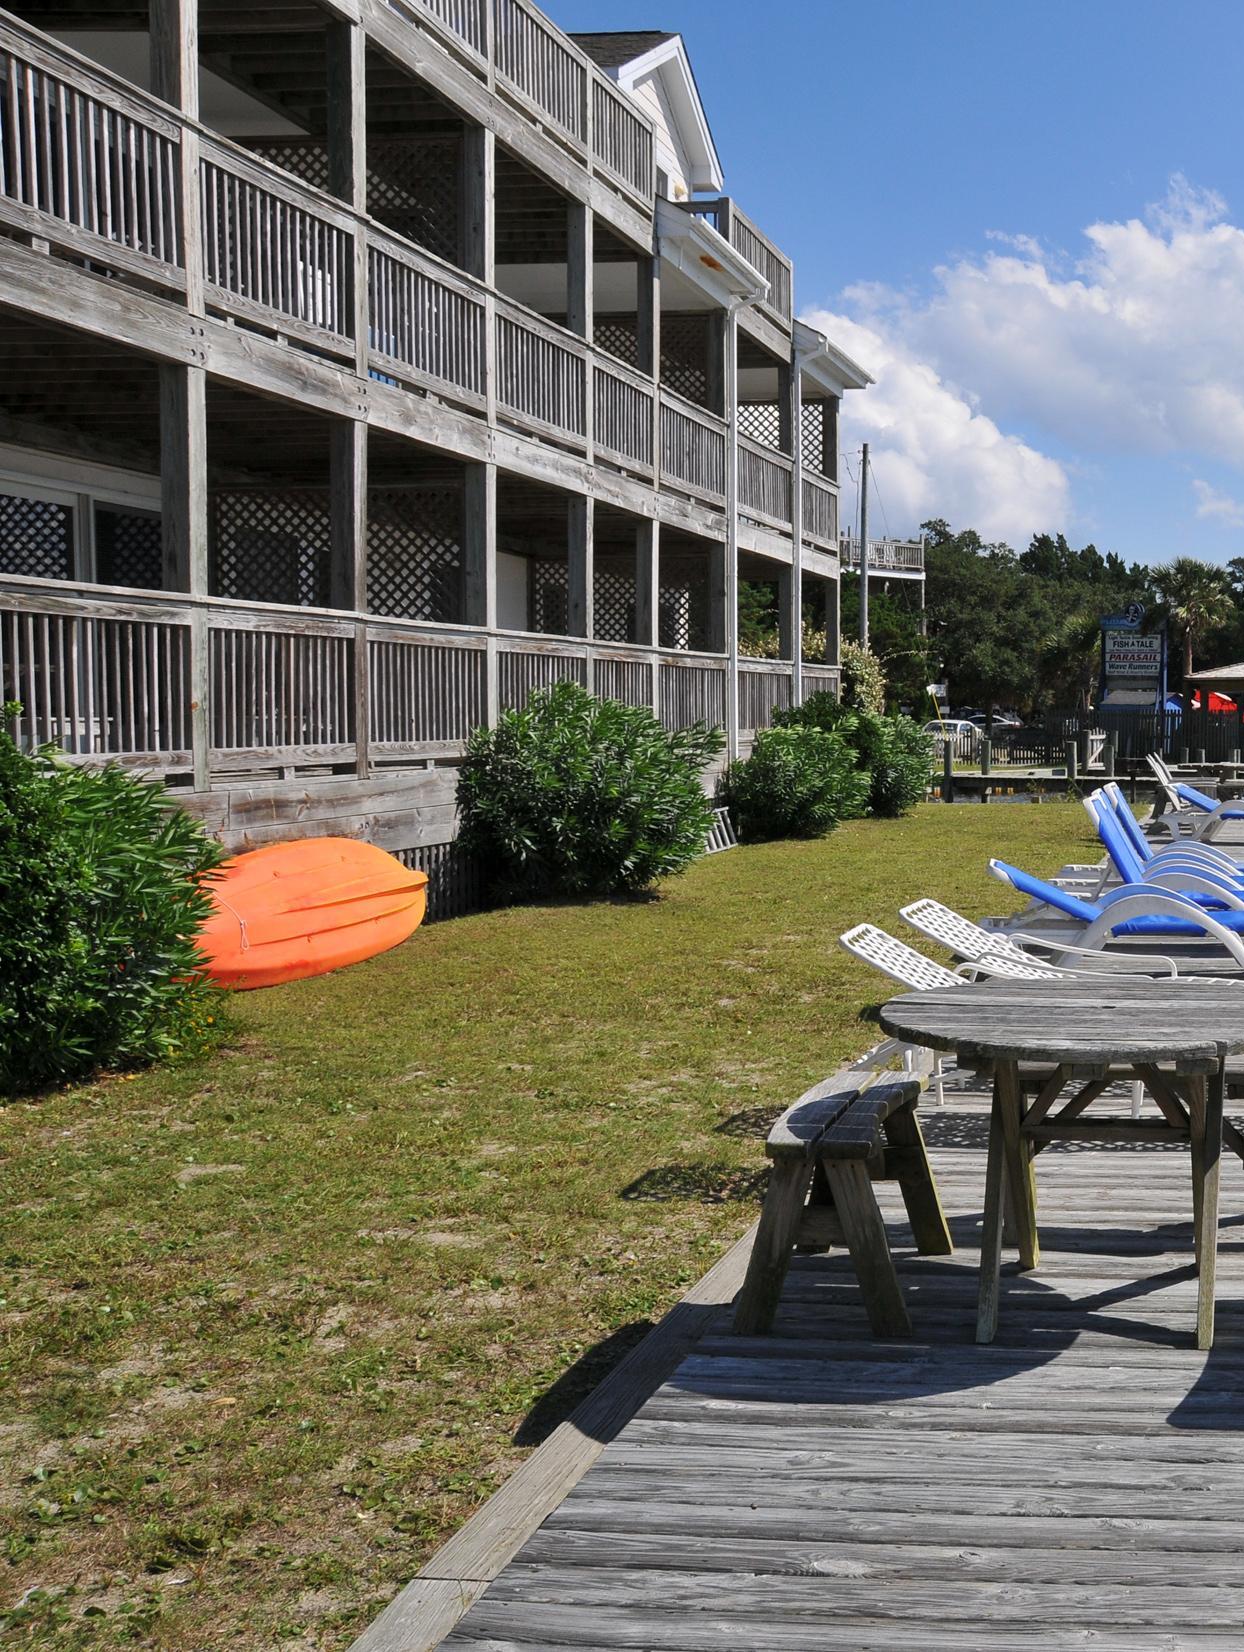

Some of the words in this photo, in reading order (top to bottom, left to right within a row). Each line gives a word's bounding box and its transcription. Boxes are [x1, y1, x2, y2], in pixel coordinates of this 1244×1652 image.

[1113, 640, 1129, 648] FISH
[1130, 640, 1135, 648] A
[1136, 640, 1154, 648] TALE
